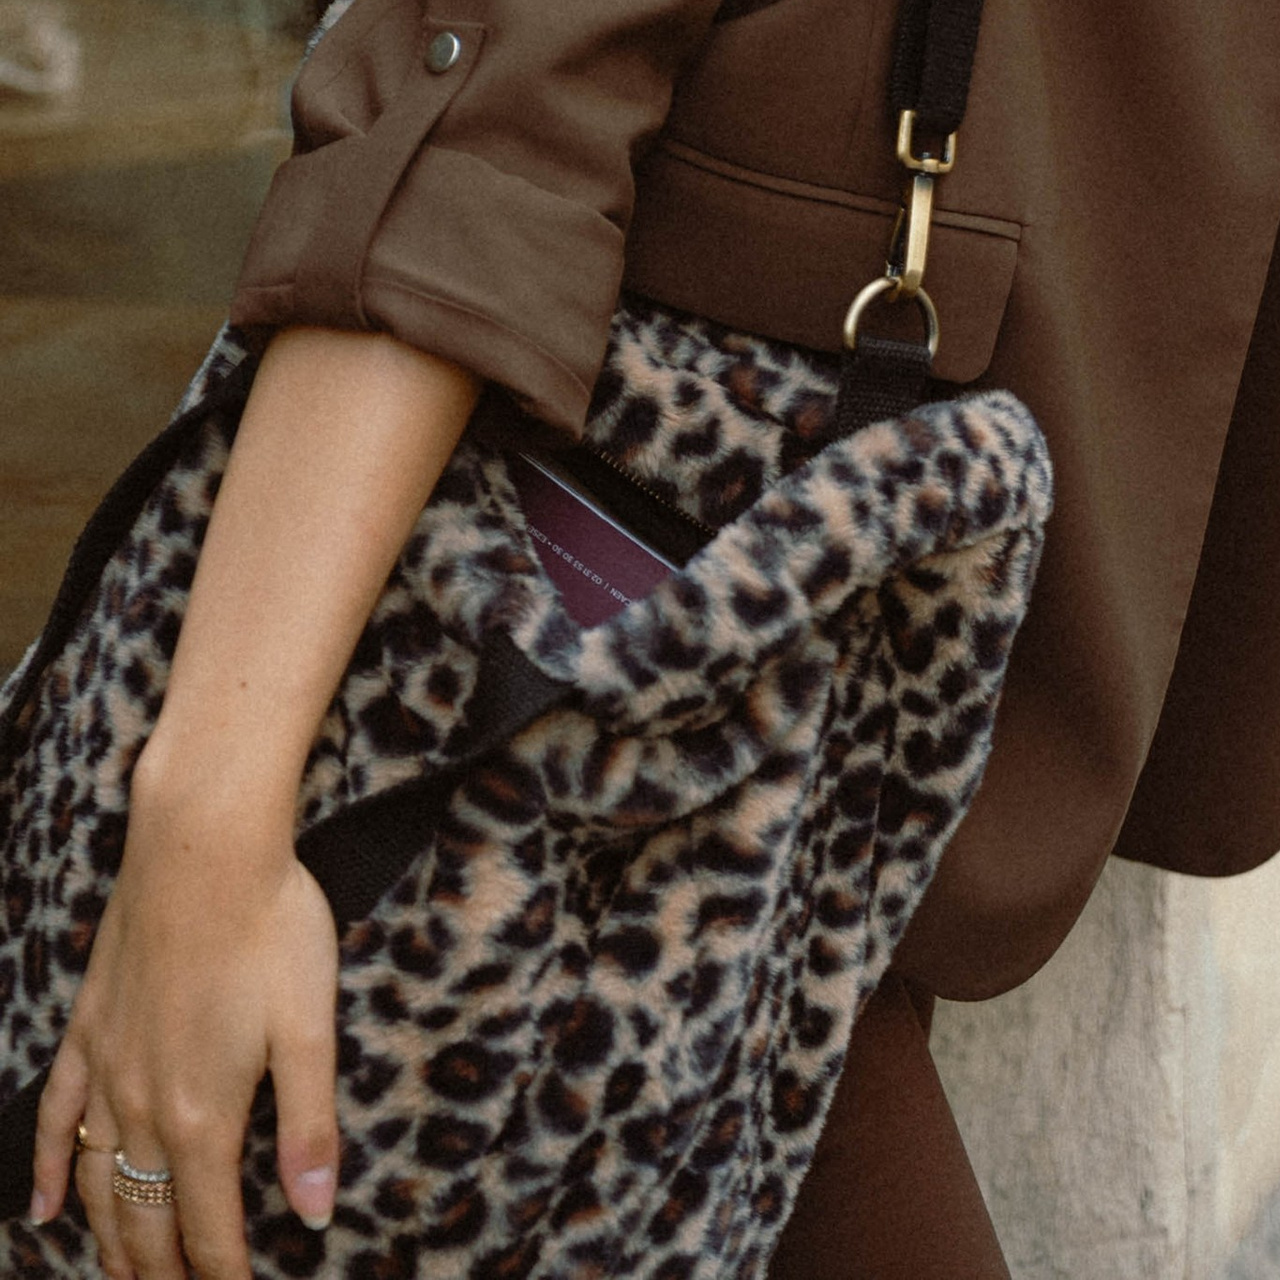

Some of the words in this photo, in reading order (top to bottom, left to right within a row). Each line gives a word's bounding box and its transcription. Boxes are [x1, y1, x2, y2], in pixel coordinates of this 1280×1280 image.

[562, 552, 574, 563] 30
[591, 574, 603, 585] 02
[609, 587, 631, 606] CAEN
